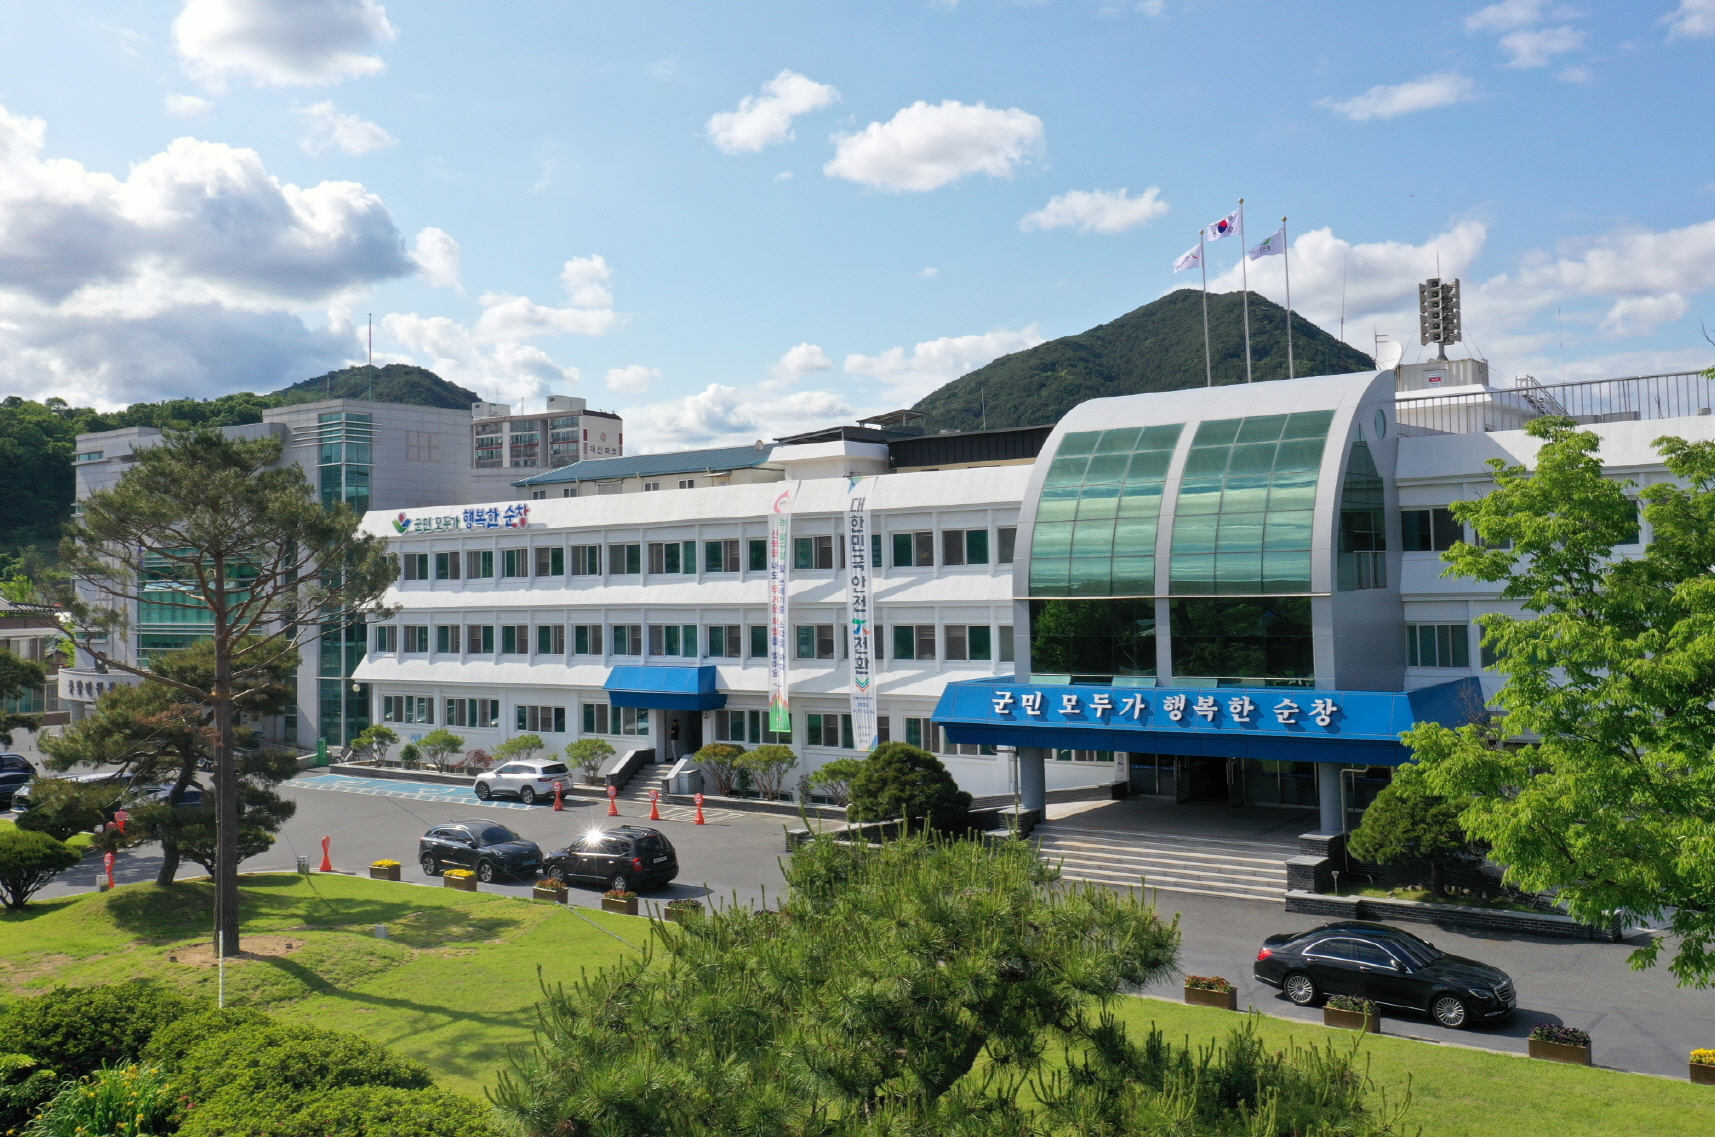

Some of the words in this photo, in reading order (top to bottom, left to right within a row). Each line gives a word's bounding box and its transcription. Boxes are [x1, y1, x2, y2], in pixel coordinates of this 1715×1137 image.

[414, 518, 432, 533] 군민
[434, 515, 461, 531] 모두가
[463, 507, 499, 530] 행복한
[503, 503, 531, 529] 순창
[849, 497, 867, 571] 대한민국
[851, 576, 867, 613] 안전
[991, 690, 1043, 715] 군민
[1057, 693, 1145, 720] 모두가
[1163, 695, 1255, 723] 행복한
[1273, 697, 1338, 727] 순창
